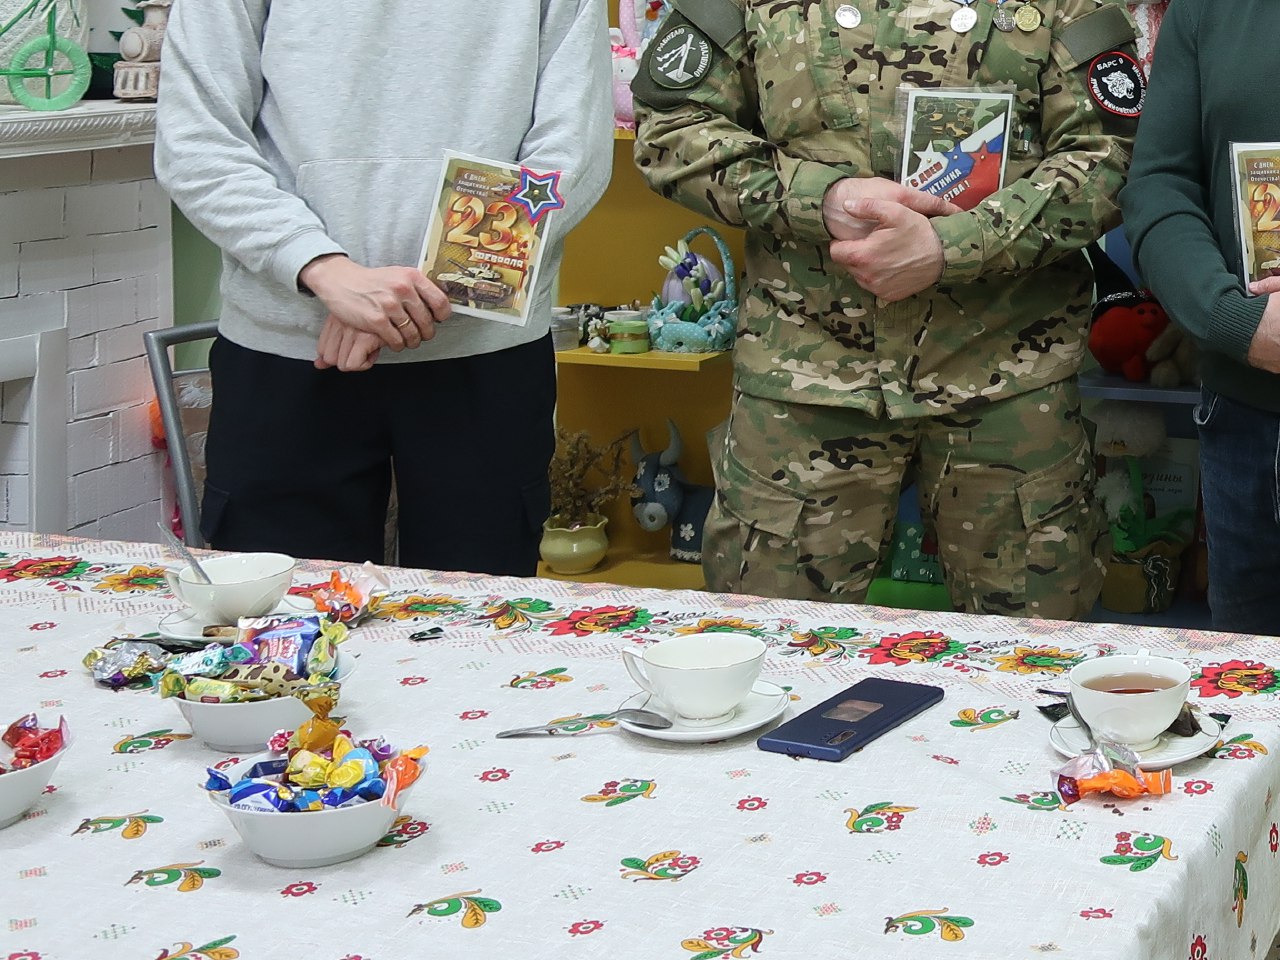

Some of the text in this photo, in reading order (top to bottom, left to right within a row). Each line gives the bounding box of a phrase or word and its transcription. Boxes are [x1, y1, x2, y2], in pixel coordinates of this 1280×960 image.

[1096, 59, 1118, 71] БАРС
[910, 178, 919, 188] С
[926, 168, 962, 195] ИТНИКА
[446, 195, 518, 251] 23
